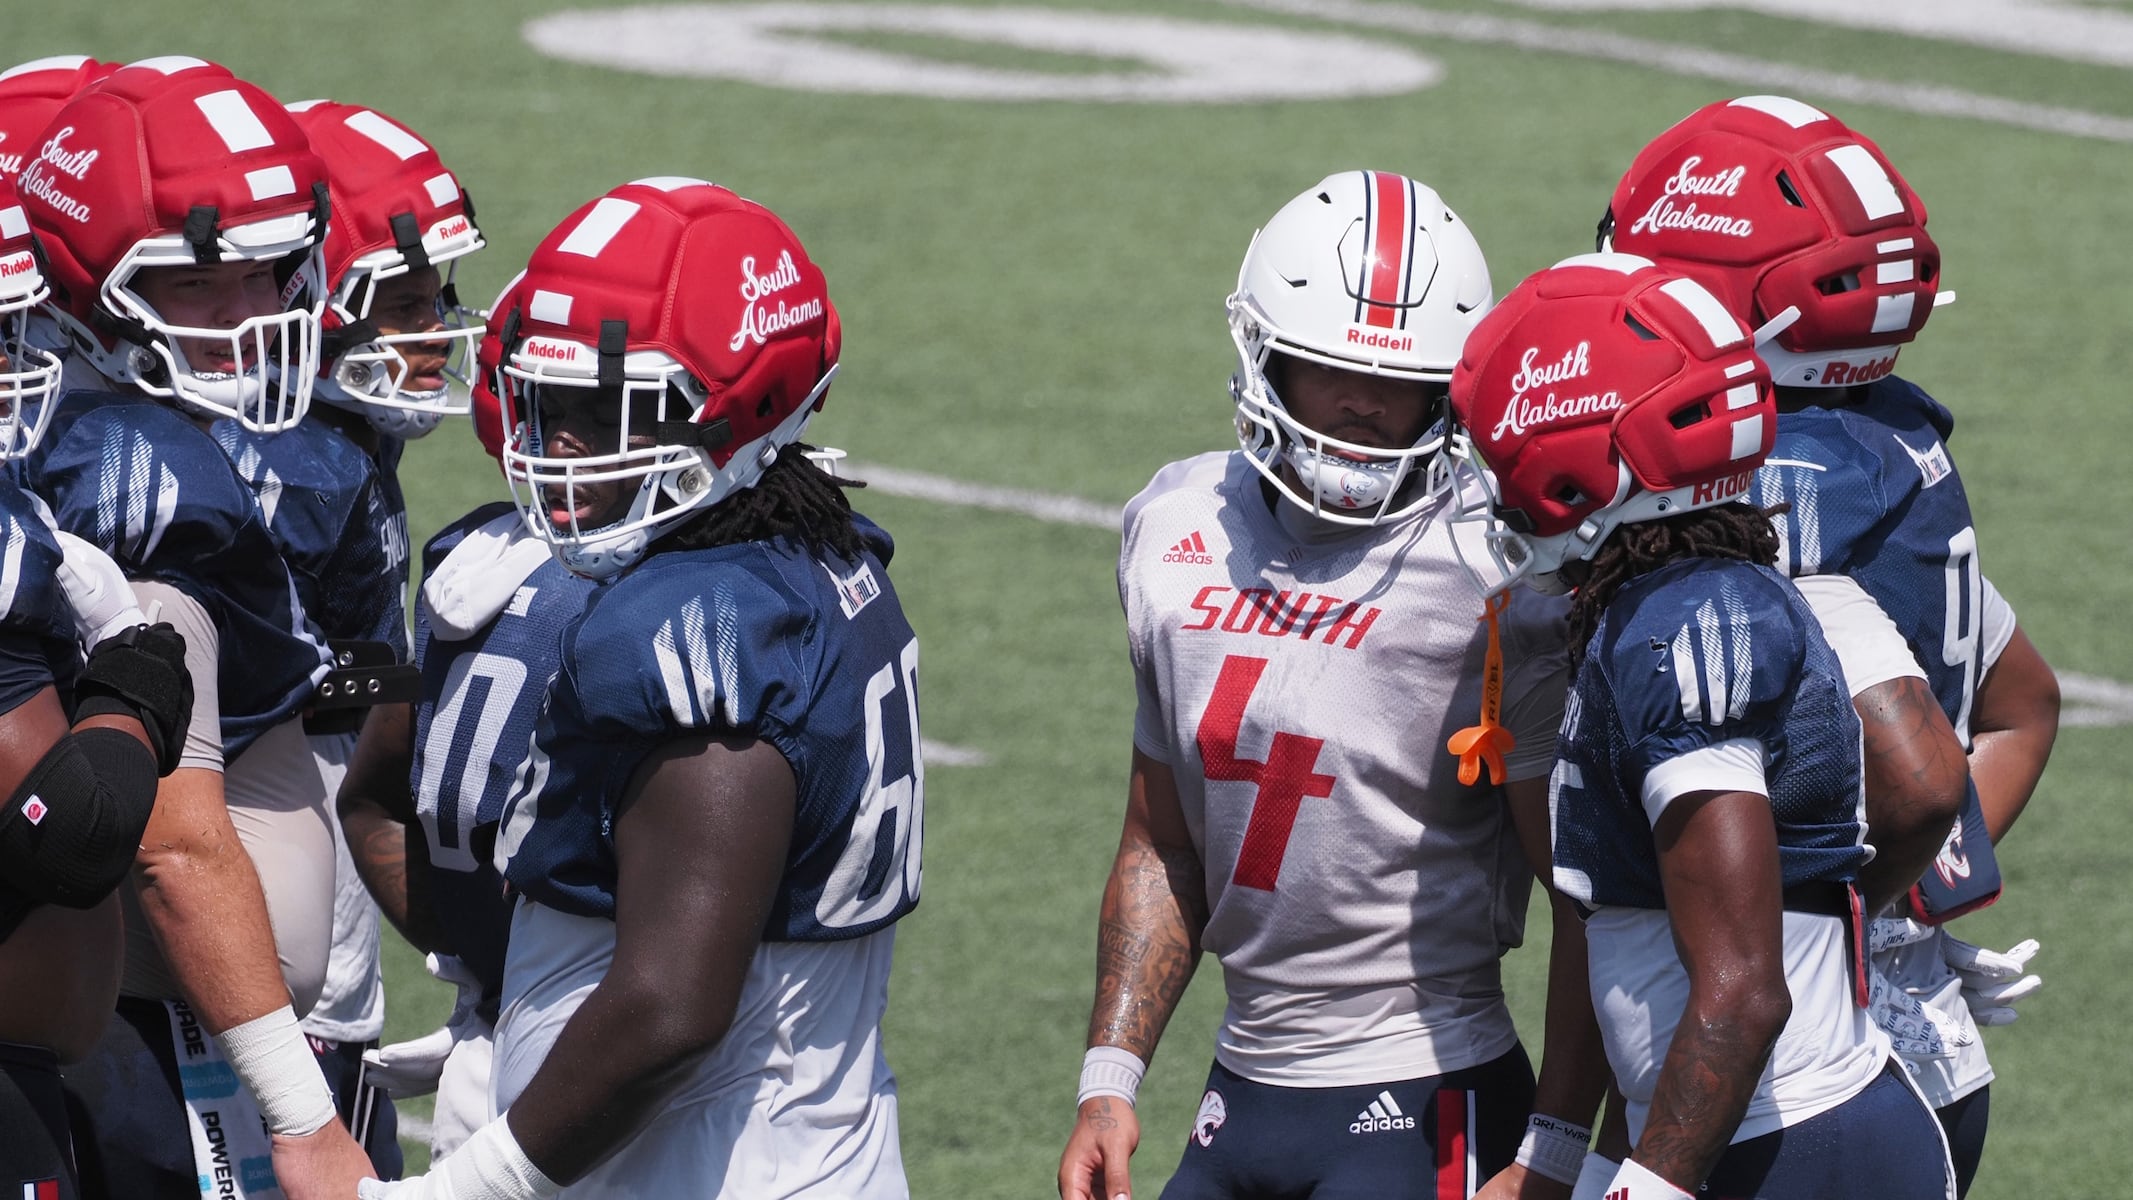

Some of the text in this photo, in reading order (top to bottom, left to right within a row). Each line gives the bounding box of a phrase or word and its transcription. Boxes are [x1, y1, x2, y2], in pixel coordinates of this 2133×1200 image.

[40, 126, 99, 181] South
[1663, 155, 1746, 198] South
[17, 157, 91, 223] Alabama
[1629, 194, 1753, 237] Alabama
[740, 249, 801, 302] South
[729, 298, 822, 352] Alabama
[1347, 329, 1412, 351] Riddell
[528, 341, 577, 361] Riddell
[1511, 341, 1589, 393] South
[1491, 390, 1622, 441] Alabama
[1162, 551, 1214, 566] adidas
[1181, 585, 1383, 651] SOUTH
[1195, 654, 1337, 893] 4
[1349, 1115, 1416, 1135] adidas
